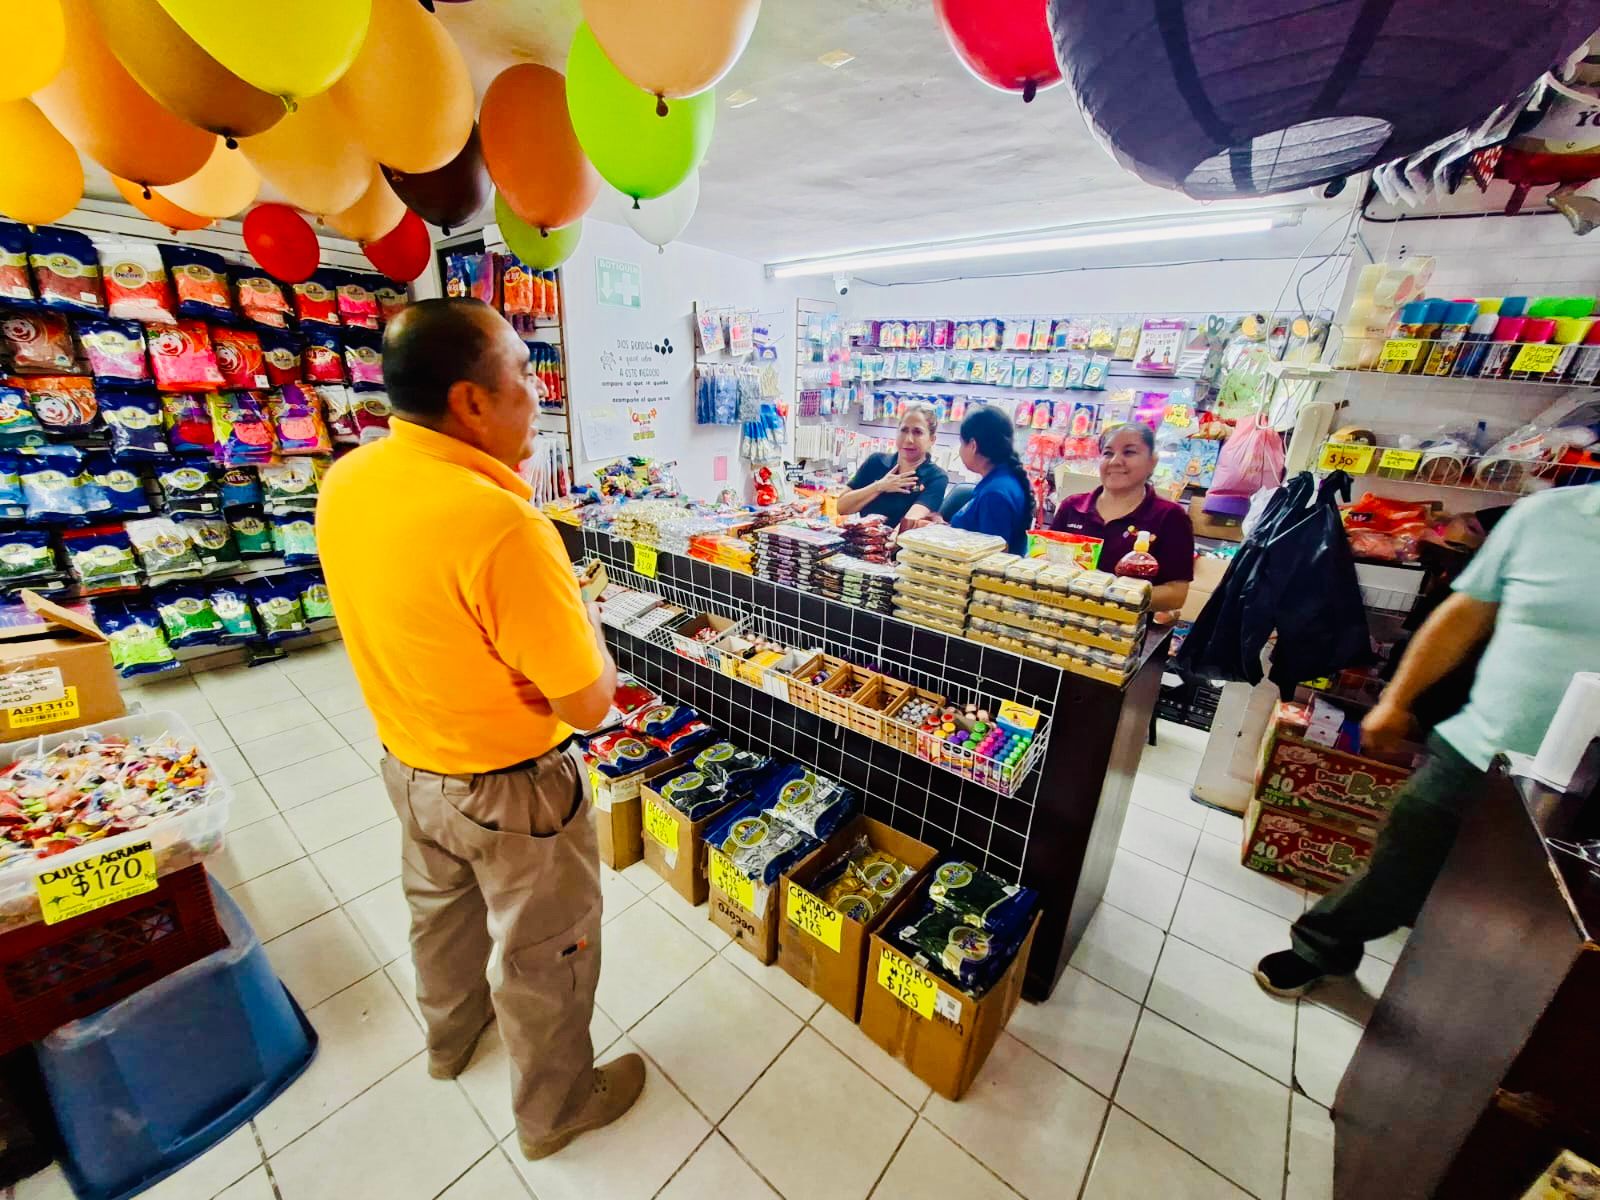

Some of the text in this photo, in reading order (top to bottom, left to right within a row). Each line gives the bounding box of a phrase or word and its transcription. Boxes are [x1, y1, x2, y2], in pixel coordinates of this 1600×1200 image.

[13, 700, 74, 716] A81310
[39, 859, 95, 885] DULCE
[71, 858, 142, 898] $120
[789, 885, 837, 922] CROMADO
[795, 911, 823, 938] $125
[882, 946, 933, 989] DECORO
[886, 976, 919, 1009] $125
